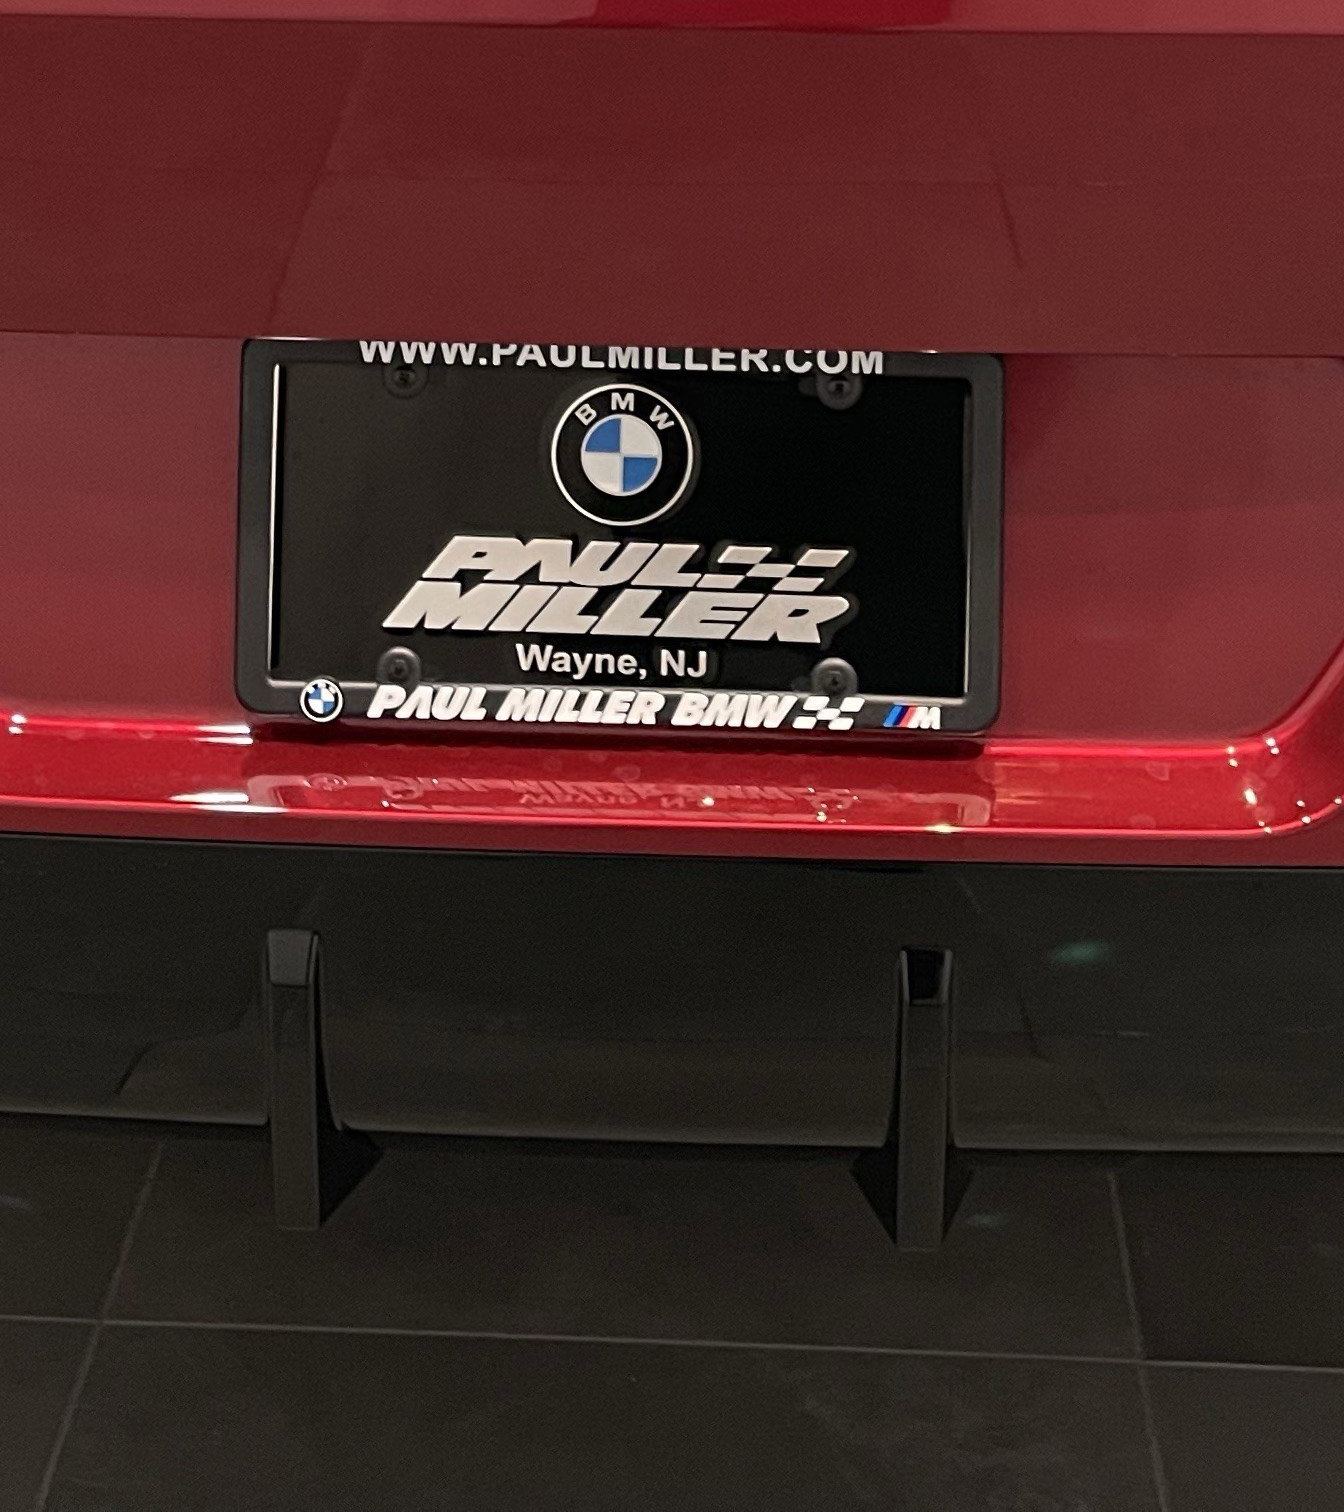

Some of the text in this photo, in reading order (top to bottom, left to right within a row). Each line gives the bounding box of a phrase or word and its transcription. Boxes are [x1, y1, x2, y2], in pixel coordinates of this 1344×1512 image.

[359, 340, 884, 375] WWW.PAULMILLER.COM
[574, 392, 675, 430] BMW
[422, 535, 702, 586] PAUL
[382, 580, 850, 644] MILLER
[515, 643, 708, 680] Wayne, NJ
[367, 684, 798, 729] PAUL MILLER BMW
